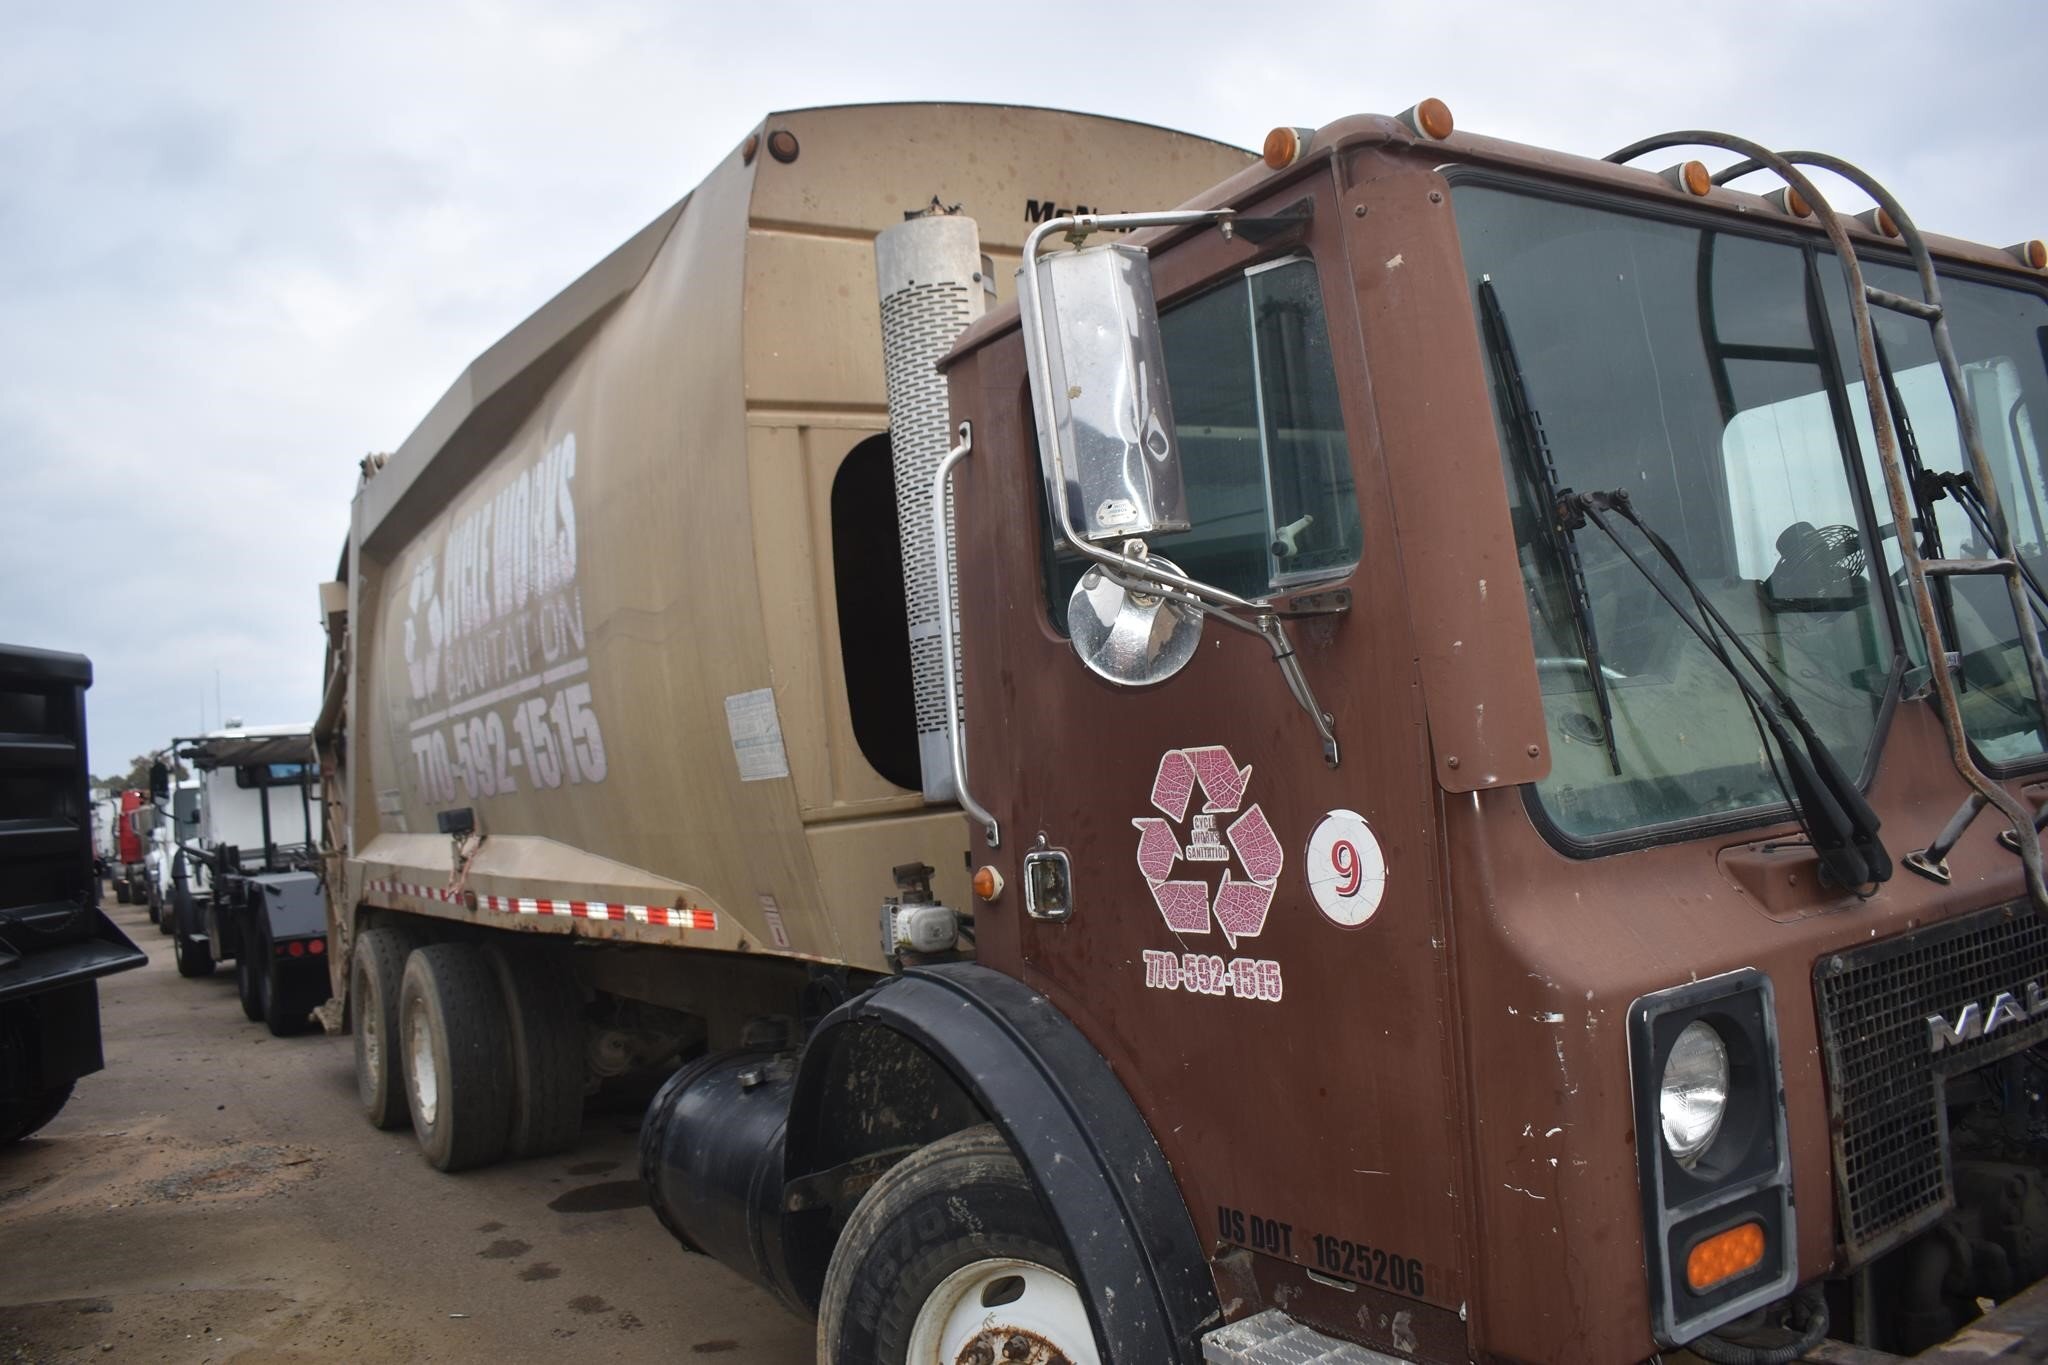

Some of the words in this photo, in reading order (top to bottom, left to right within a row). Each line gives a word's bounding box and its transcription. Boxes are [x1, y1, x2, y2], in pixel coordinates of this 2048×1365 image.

[411, 682, 608, 803] 770-592-1515
[1194, 816, 1217, 829] CYCLE
[1187, 846, 1228, 859] SANITATION
[1331, 839, 1363, 898] 9
[1144, 951, 1282, 1001] 770-592-1515
[1217, 1205, 1246, 1245] US
[1250, 1214, 1293, 1258] DOT
[1312, 1232, 1425, 1297] 1625206
